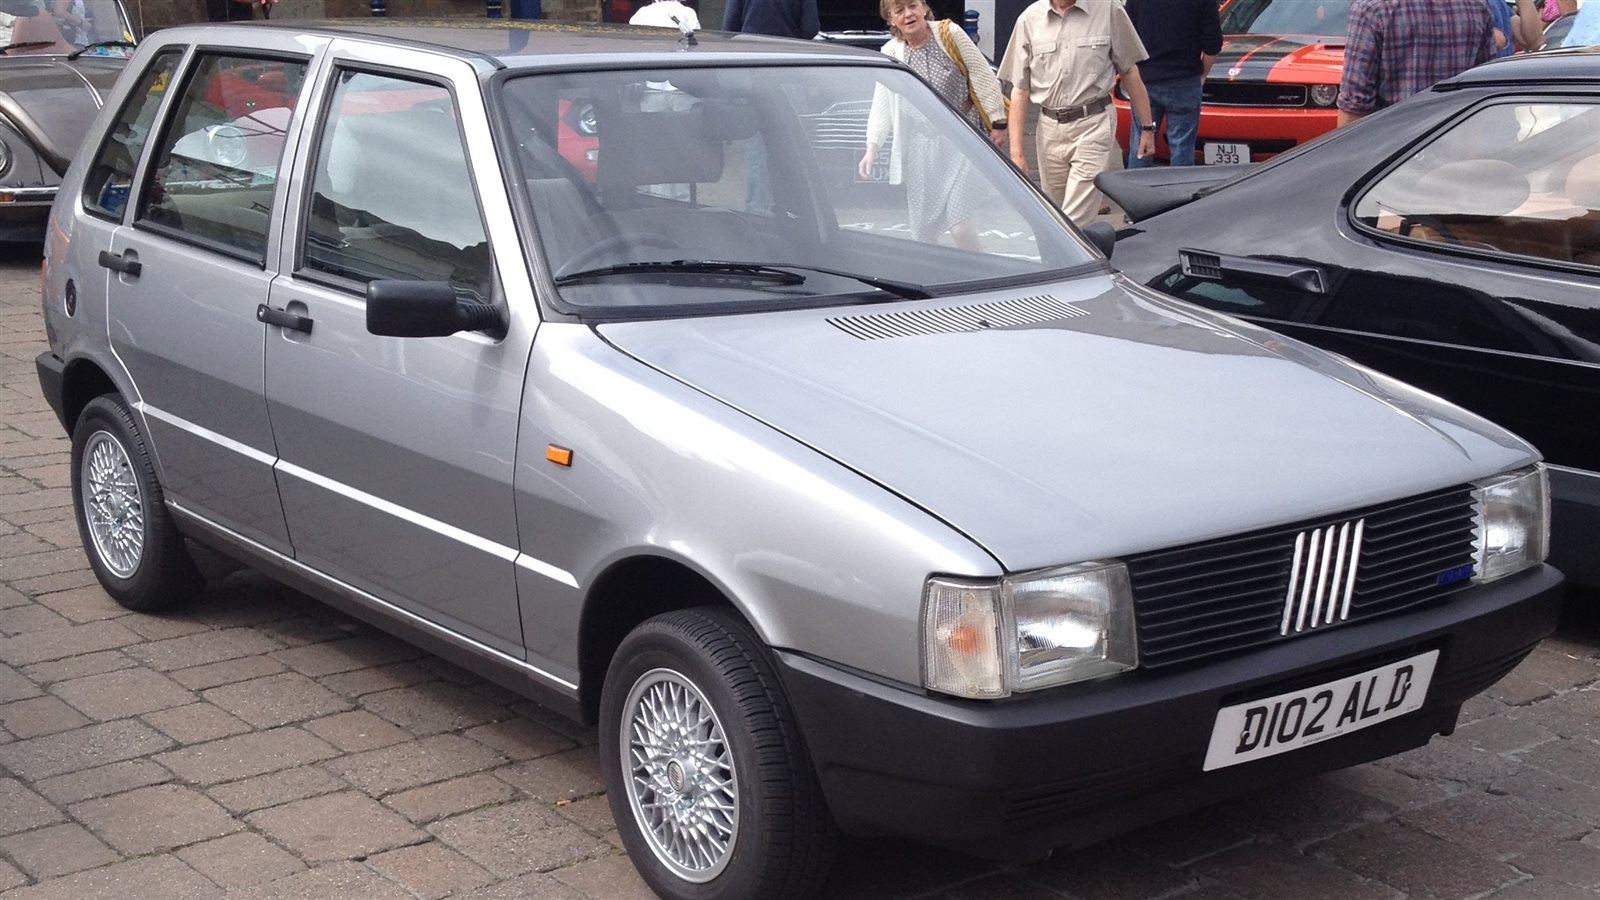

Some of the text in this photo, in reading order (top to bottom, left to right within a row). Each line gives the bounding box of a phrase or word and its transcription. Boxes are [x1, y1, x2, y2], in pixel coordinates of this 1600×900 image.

[1216, 154, 1240, 164] 333
[1235, 664, 1413, 754] D102 ALD
